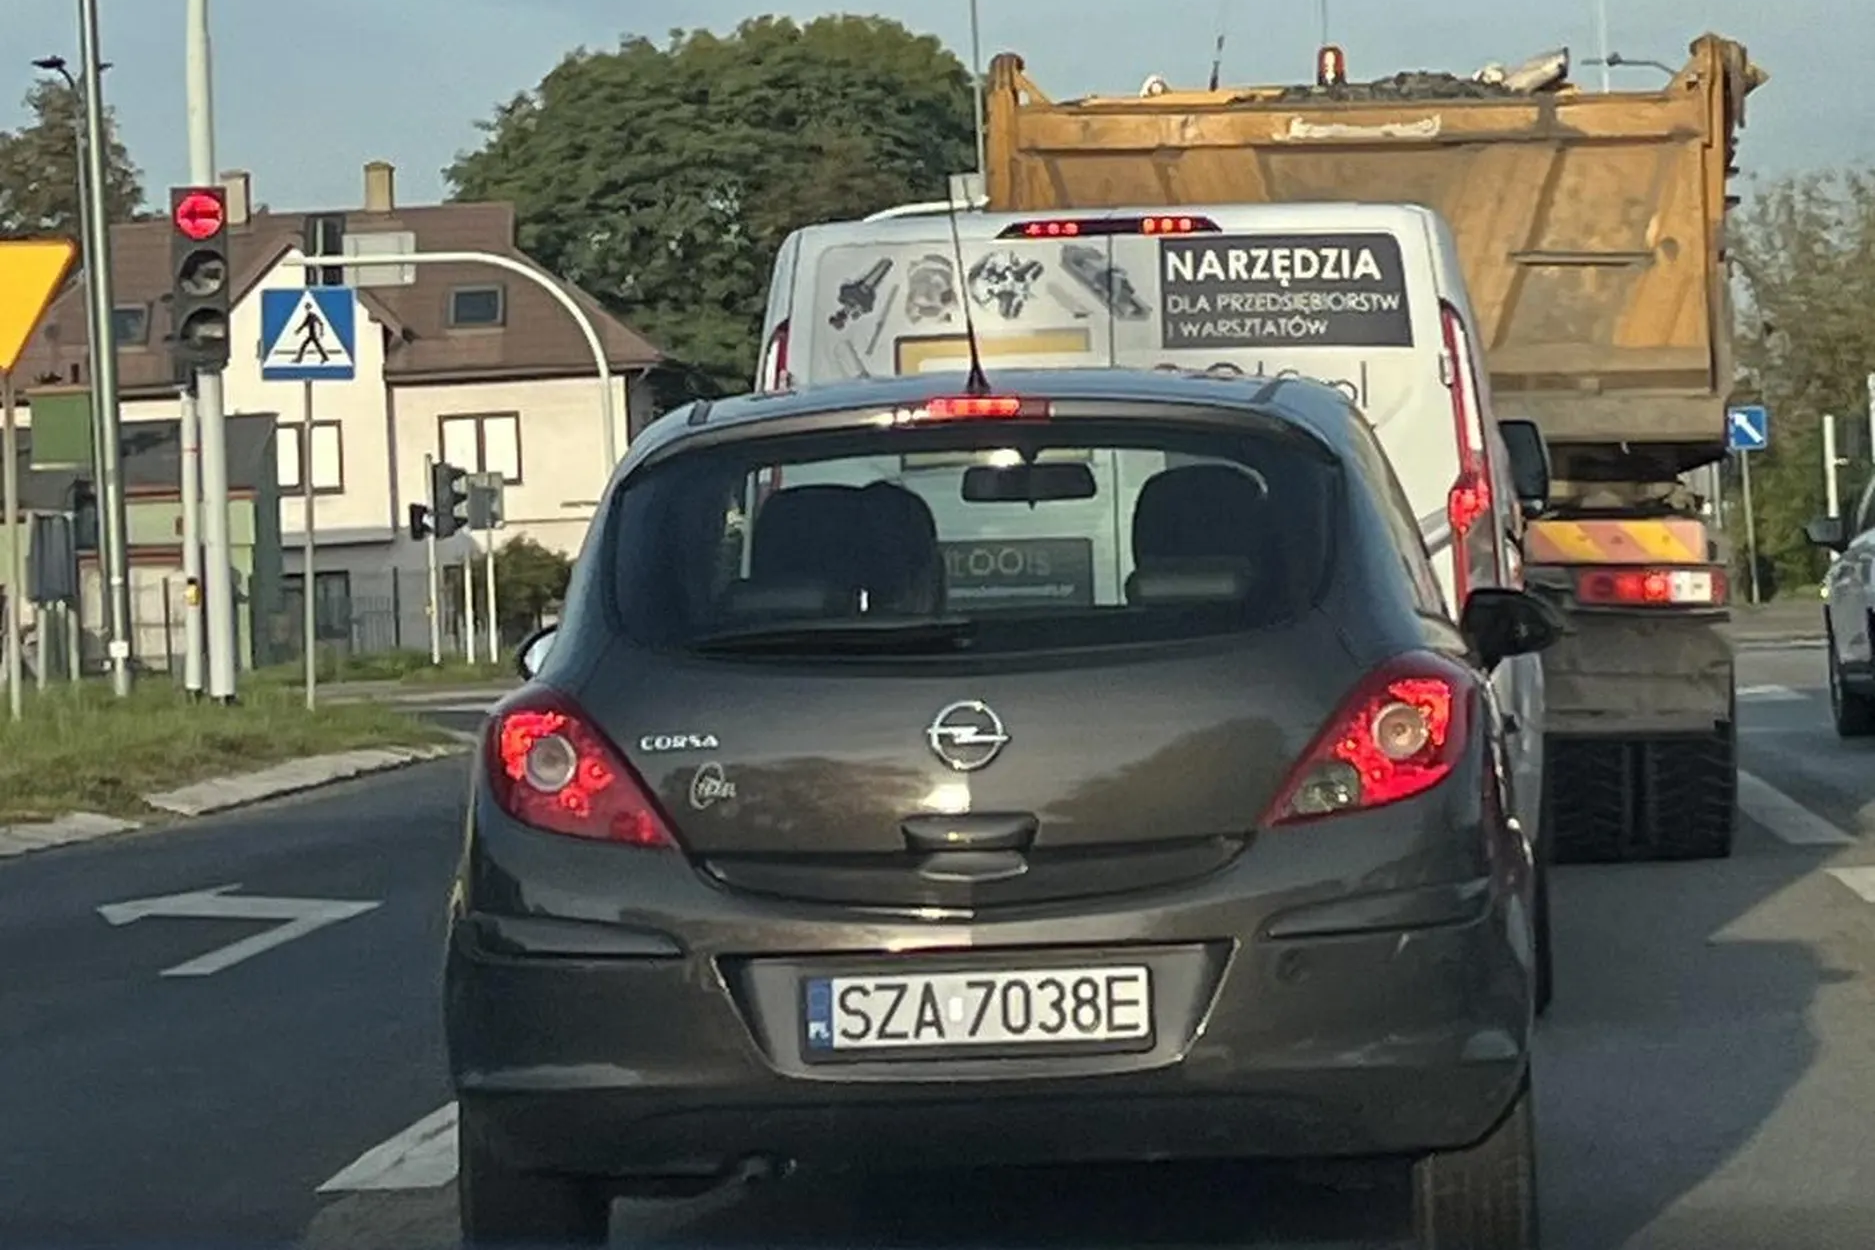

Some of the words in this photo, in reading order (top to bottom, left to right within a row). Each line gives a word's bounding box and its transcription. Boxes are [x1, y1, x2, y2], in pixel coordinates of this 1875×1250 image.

[1166, 248, 1383, 287] NARZĘDZIA
[1167, 294, 1211, 314] DLA
[1216, 291, 1401, 314] PRZEDSIĘBIORSTW
[1179, 316, 1329, 338] WARSZTATÓW
[640, 735, 719, 750] CORSA
[838, 982, 945, 1040] SZA
[966, 975, 1141, 1037] 7038E
